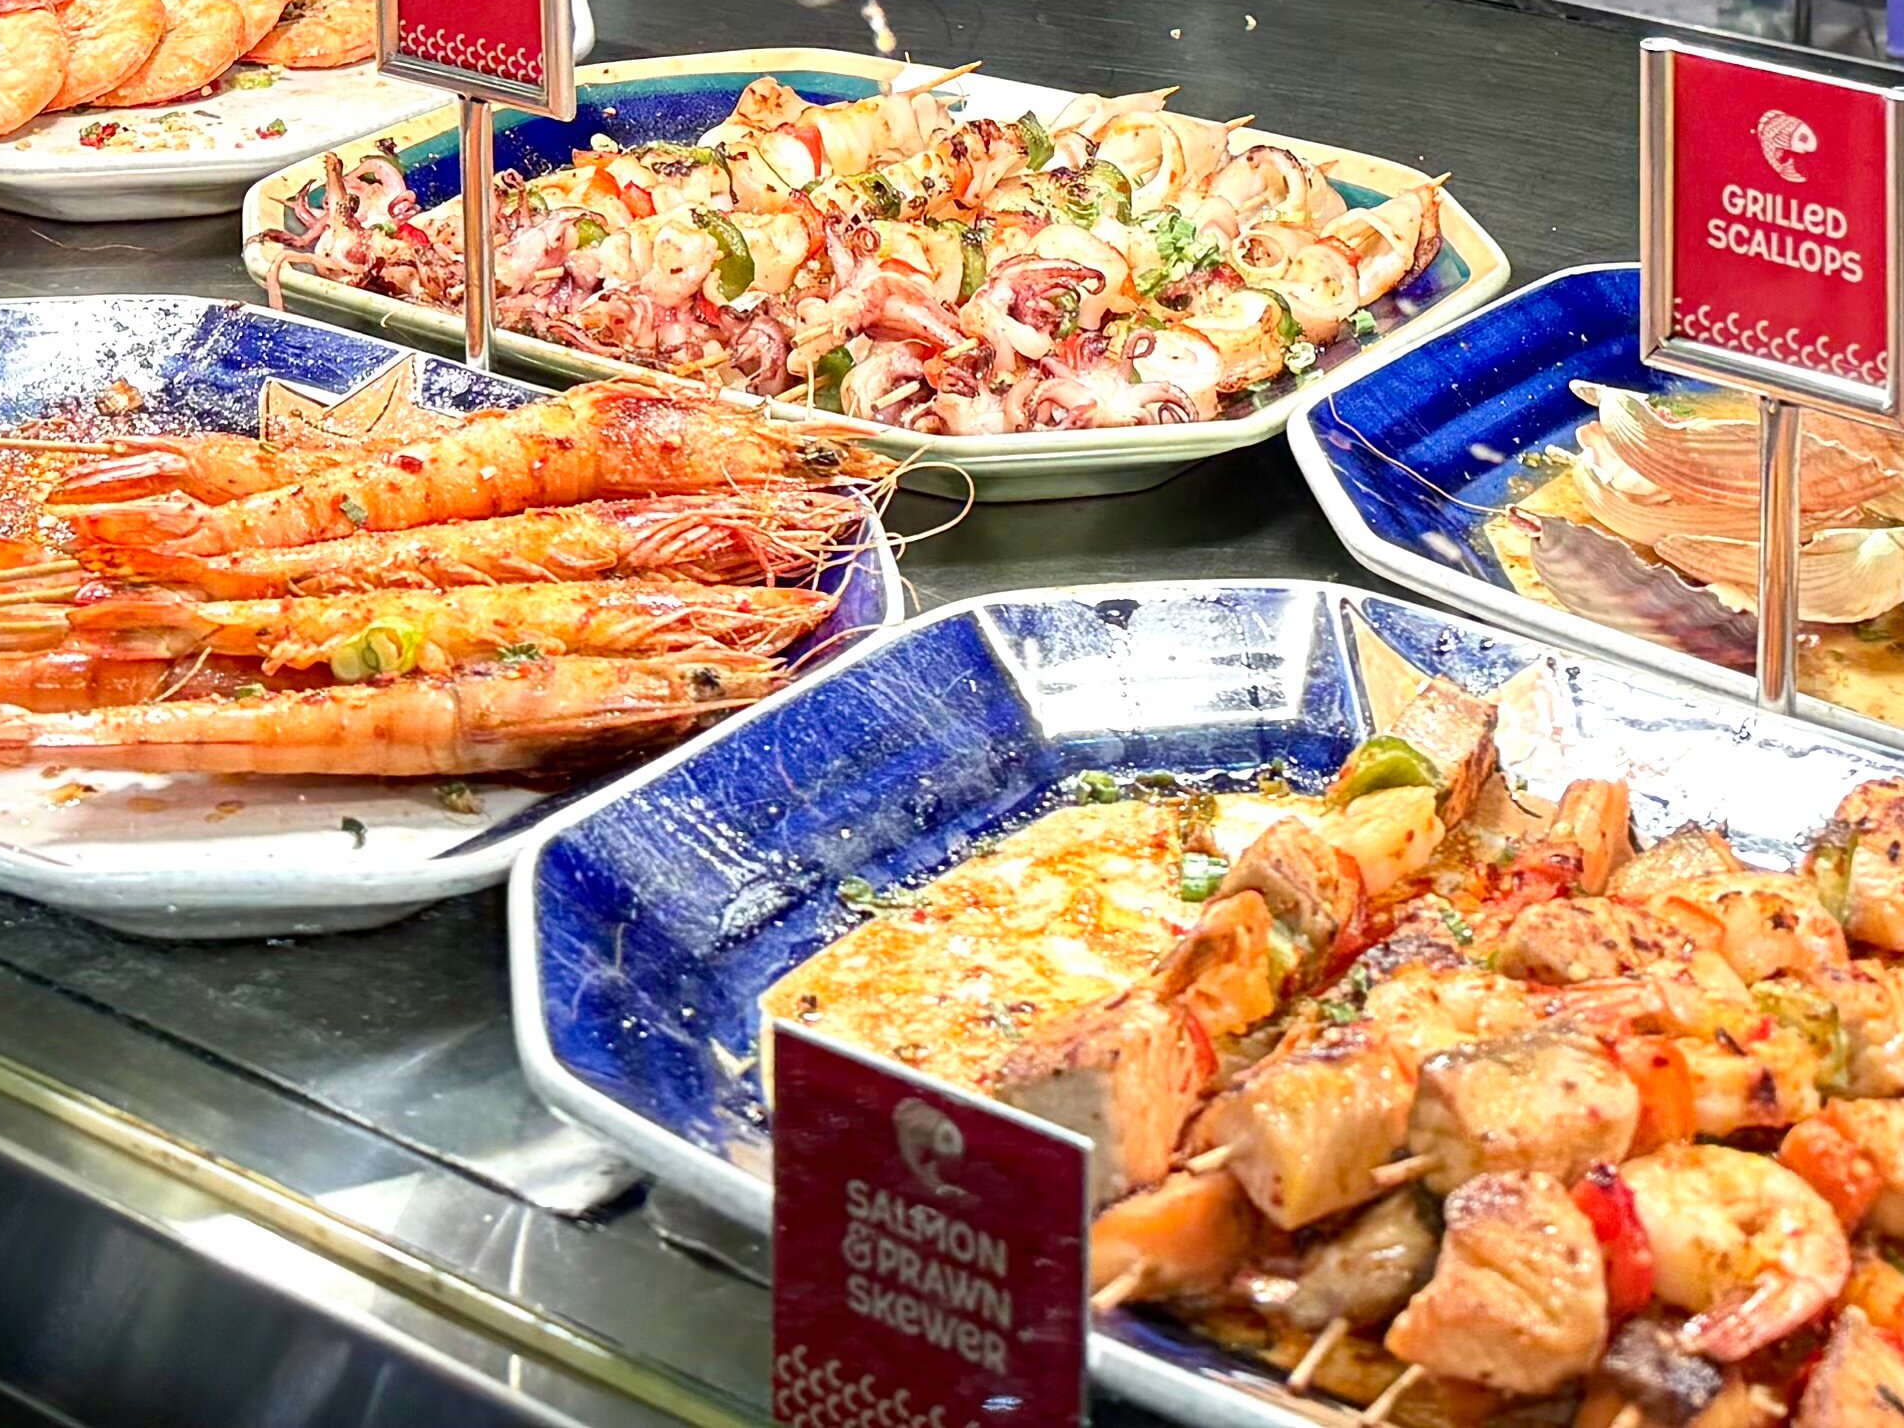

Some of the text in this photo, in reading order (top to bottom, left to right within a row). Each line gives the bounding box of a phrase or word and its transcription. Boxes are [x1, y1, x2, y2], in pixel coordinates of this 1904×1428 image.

[1706, 219, 1863, 286] SCALLOPS
[841, 1223, 1013, 1330] & PRAWN
[845, 1179, 1008, 1277] SALMON
